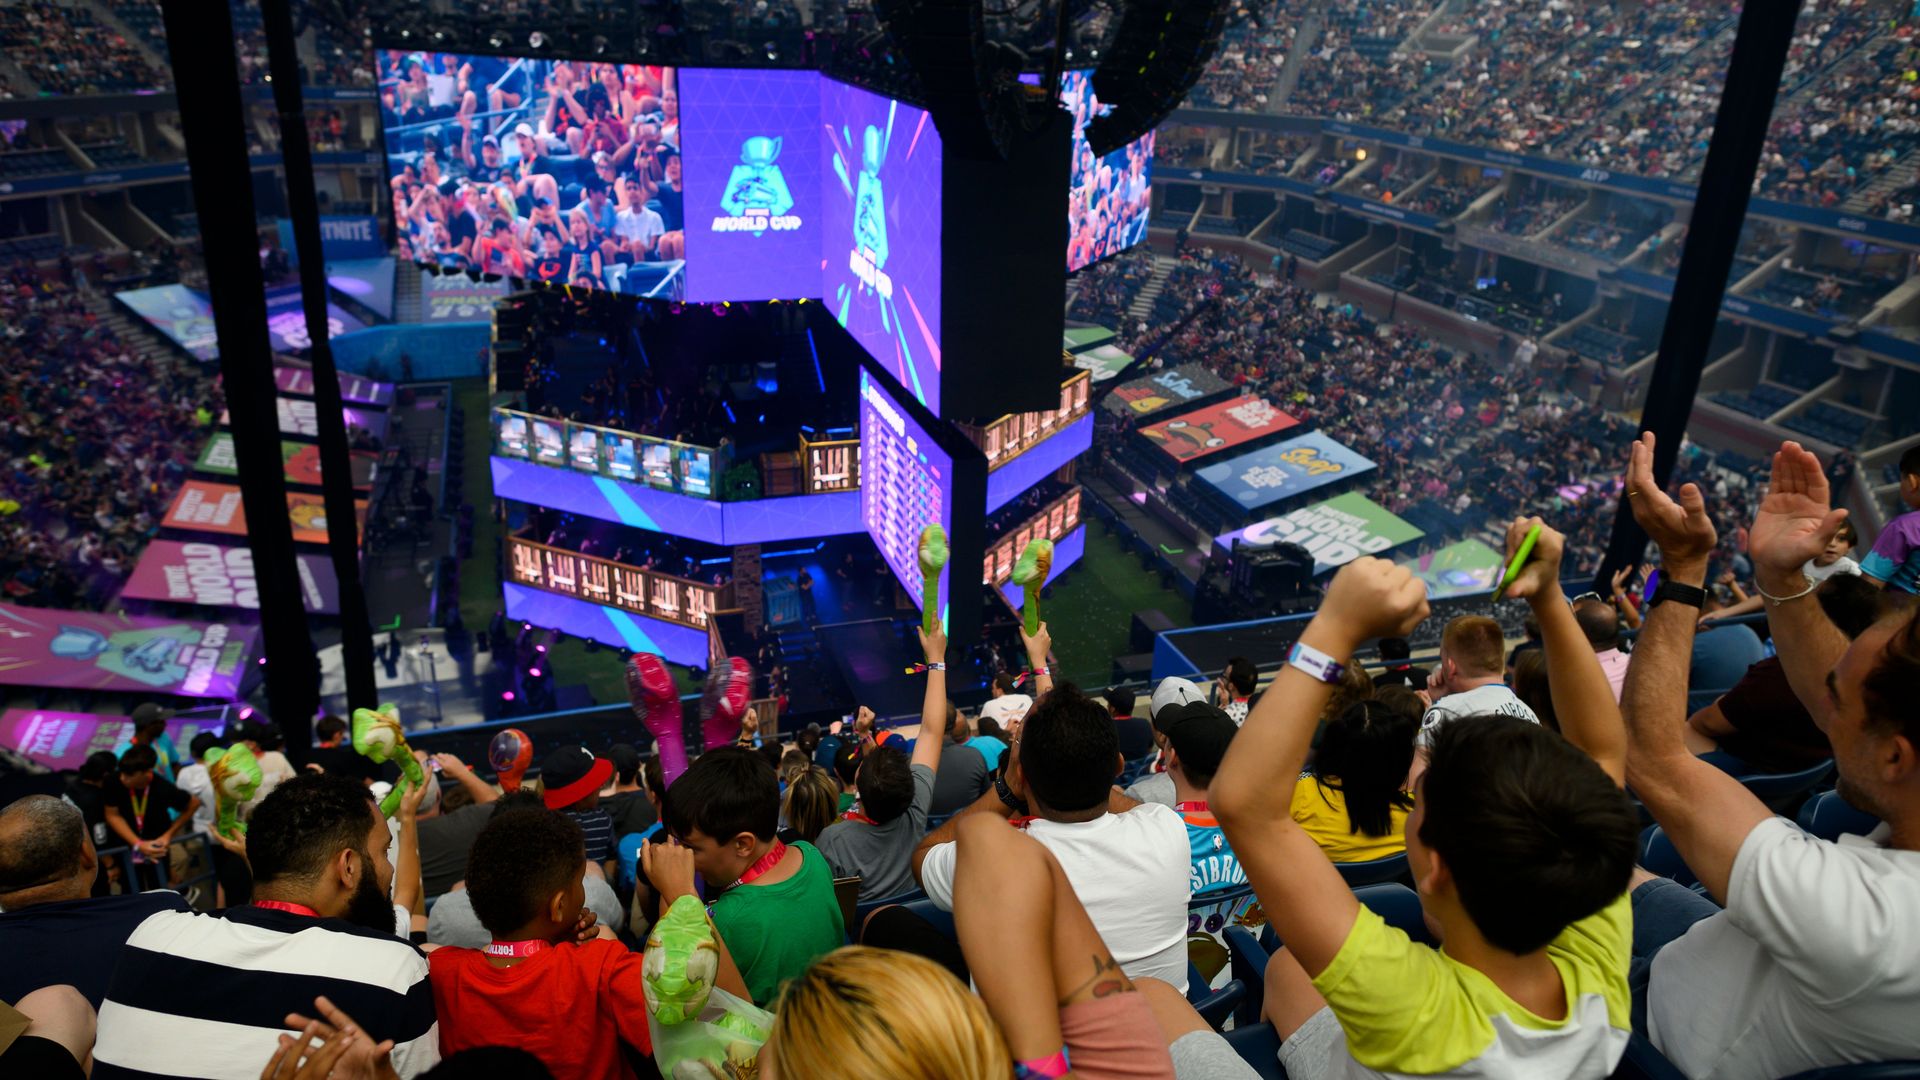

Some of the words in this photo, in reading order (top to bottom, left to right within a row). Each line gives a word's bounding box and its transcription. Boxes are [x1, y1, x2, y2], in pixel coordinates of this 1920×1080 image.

[711, 216, 768, 232] WORLD
[769, 215, 803, 231] CUP
[1287, 507, 1393, 554] WORLD
[181, 542, 235, 605] WORLD
